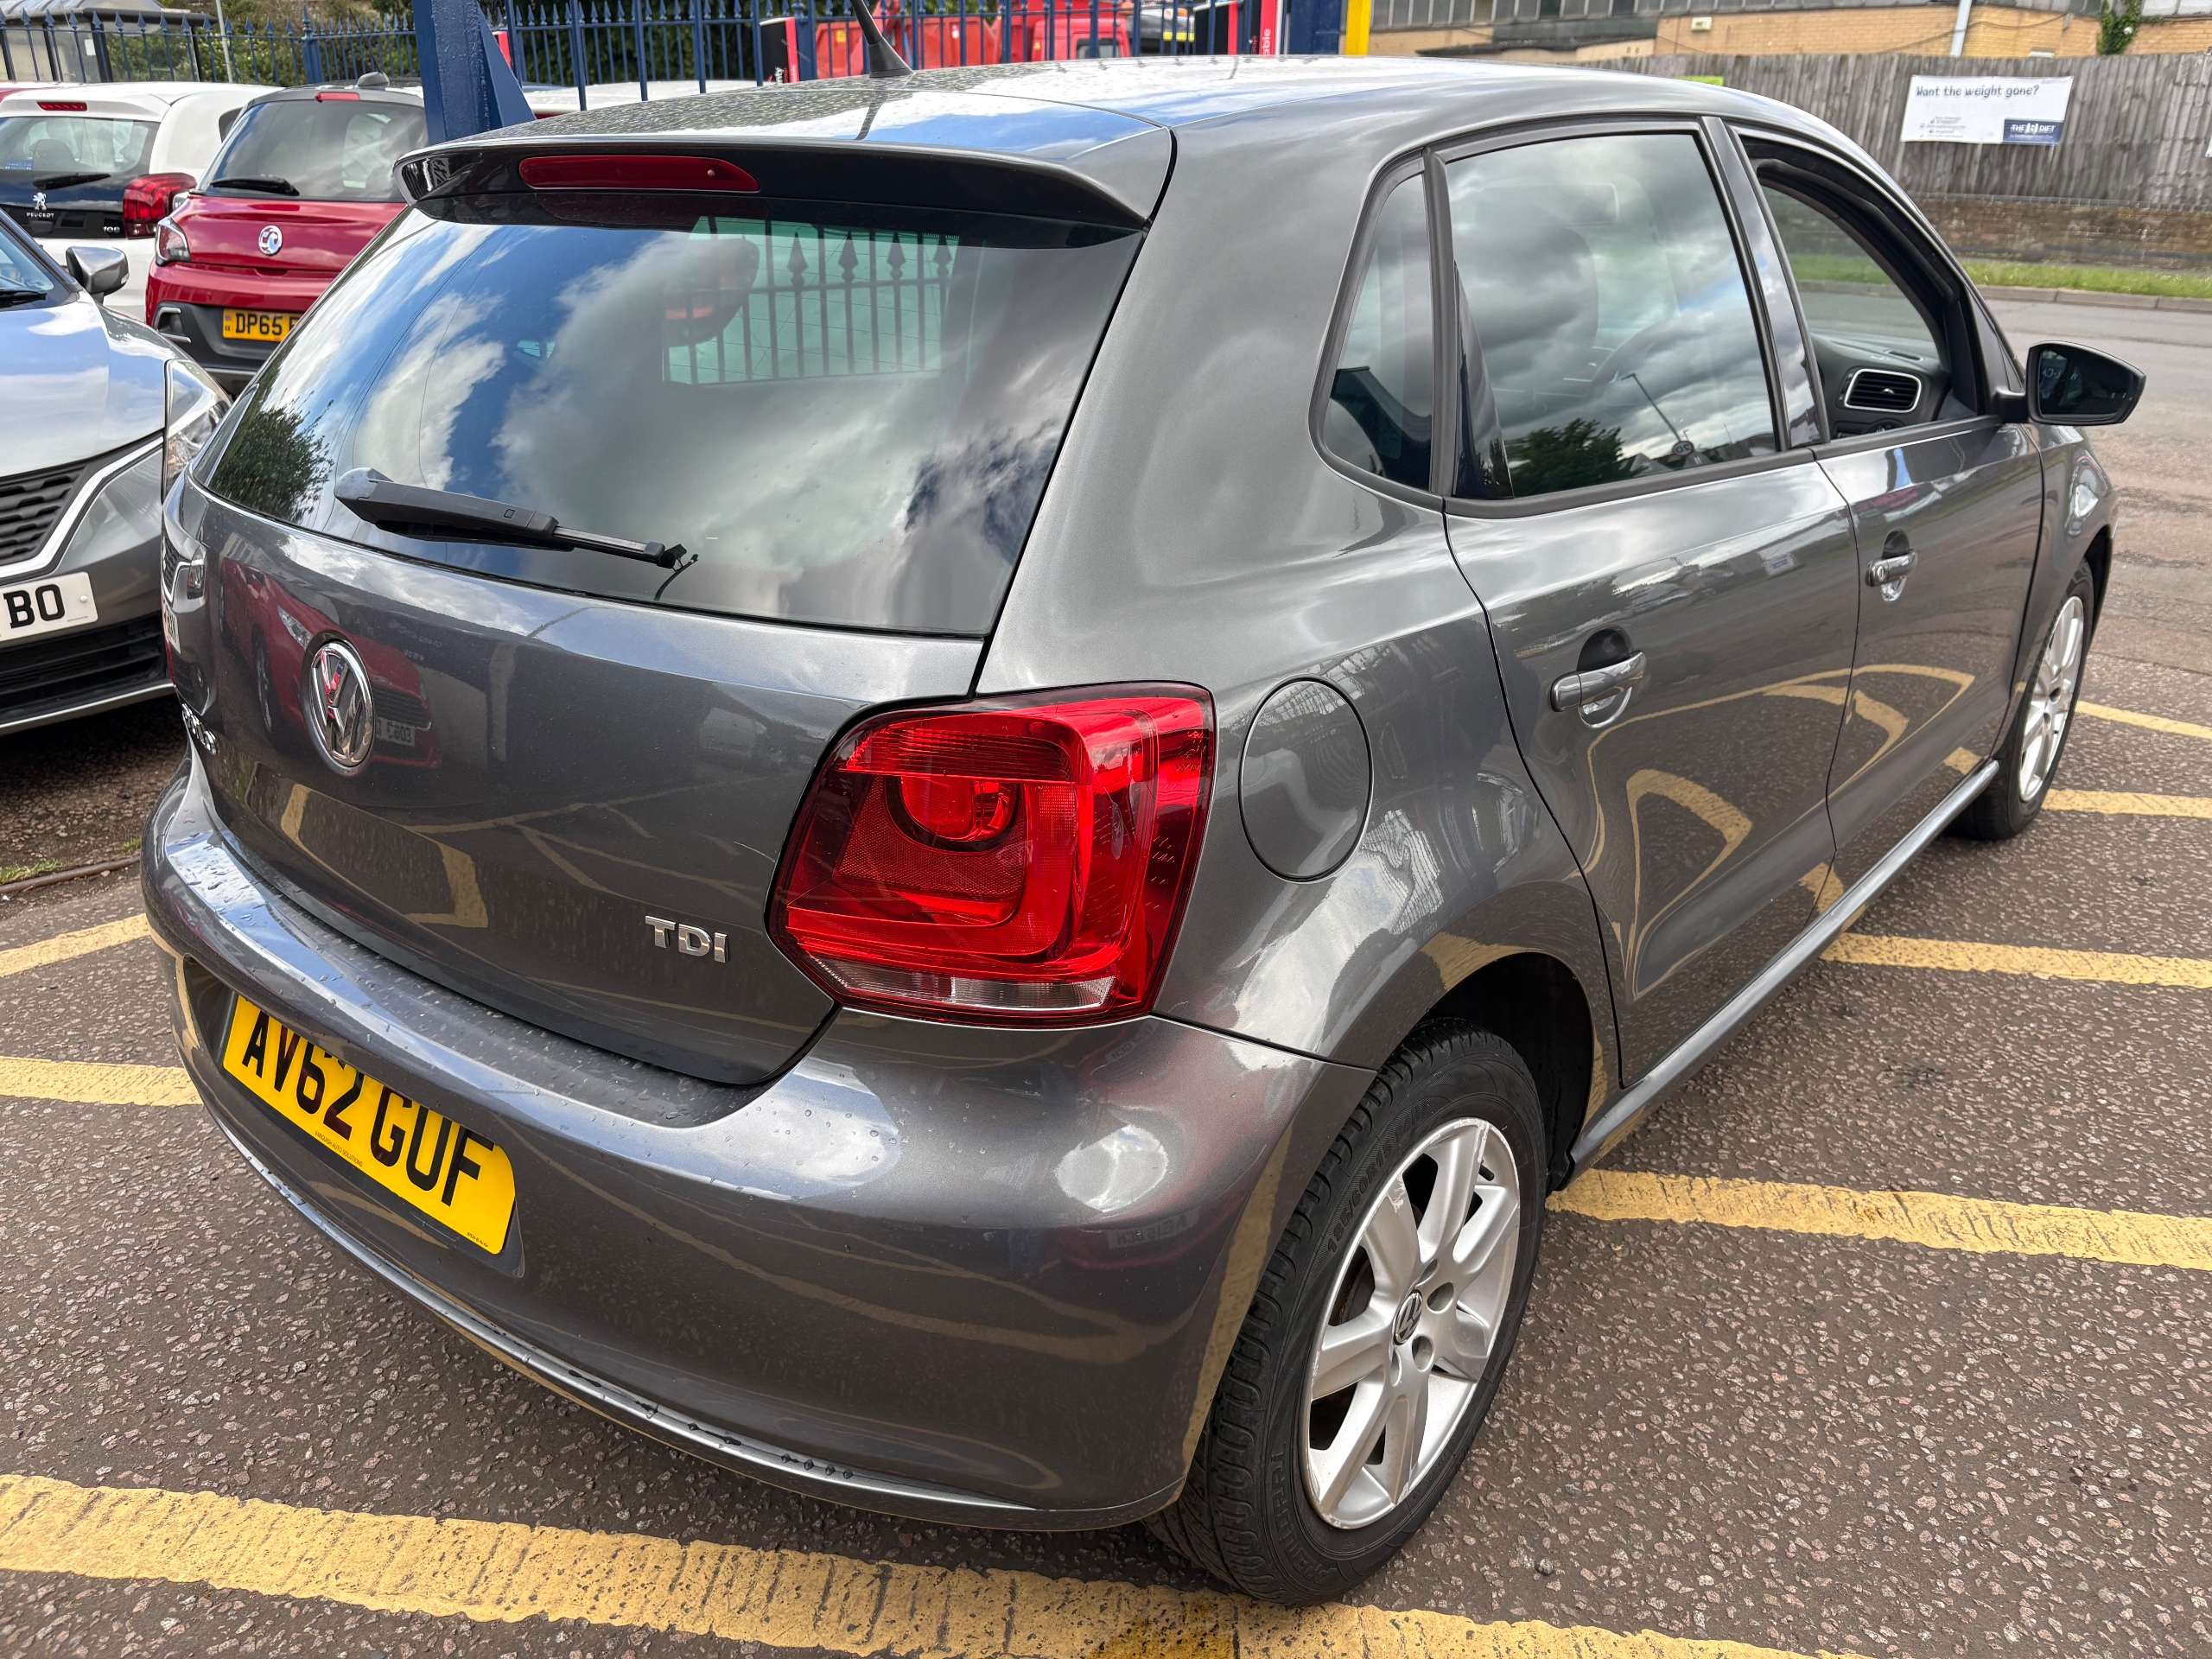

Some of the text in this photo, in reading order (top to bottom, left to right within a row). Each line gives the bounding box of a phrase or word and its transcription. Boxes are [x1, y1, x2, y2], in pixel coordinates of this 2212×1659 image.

[1916, 85, 2040, 99] Want the weight gone?
[2010, 124, 2025, 132] THE
[2039, 124, 2056, 132] DIET
[235, 312, 283, 336] DP65
[645, 915, 728, 963] TDI
[242, 1010, 495, 1207] AV62 GUF
